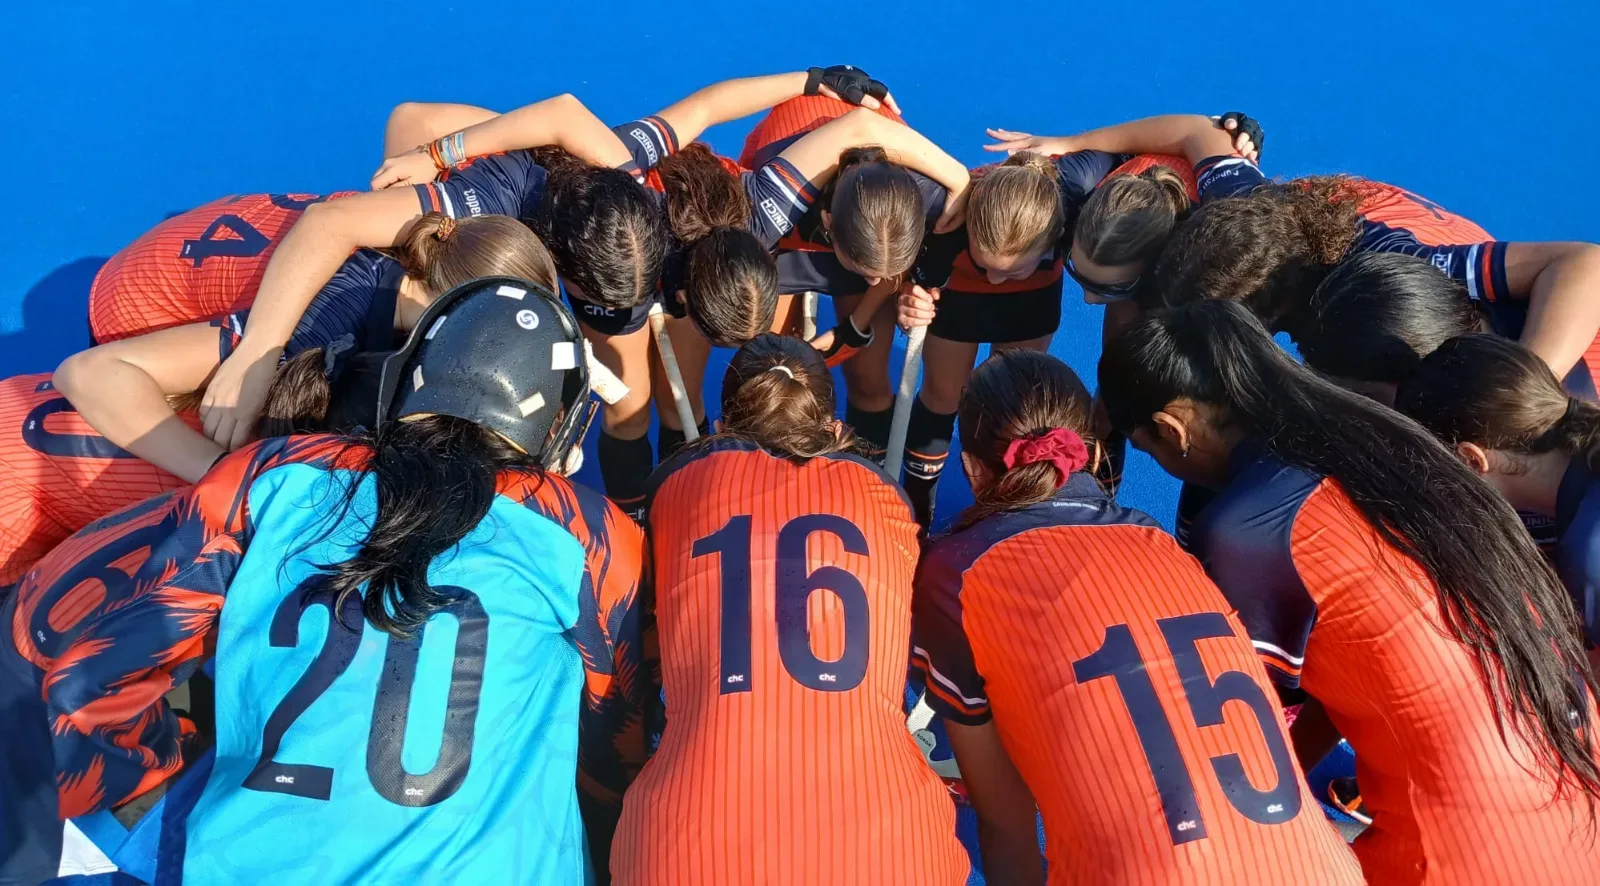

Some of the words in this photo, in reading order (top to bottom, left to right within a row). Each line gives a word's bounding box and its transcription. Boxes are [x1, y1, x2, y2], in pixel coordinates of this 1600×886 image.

[692, 513, 870, 695] 16
[727, 674, 744, 683] chc
[818, 673, 837, 682] chc
[241, 573, 489, 807] 20
[1072, 612, 1300, 845] 15
[275, 775, 295, 784] chc
[404, 788, 424, 796] chc
[1267, 804, 1284, 813] chc
[1177, 820, 1196, 831] chc
